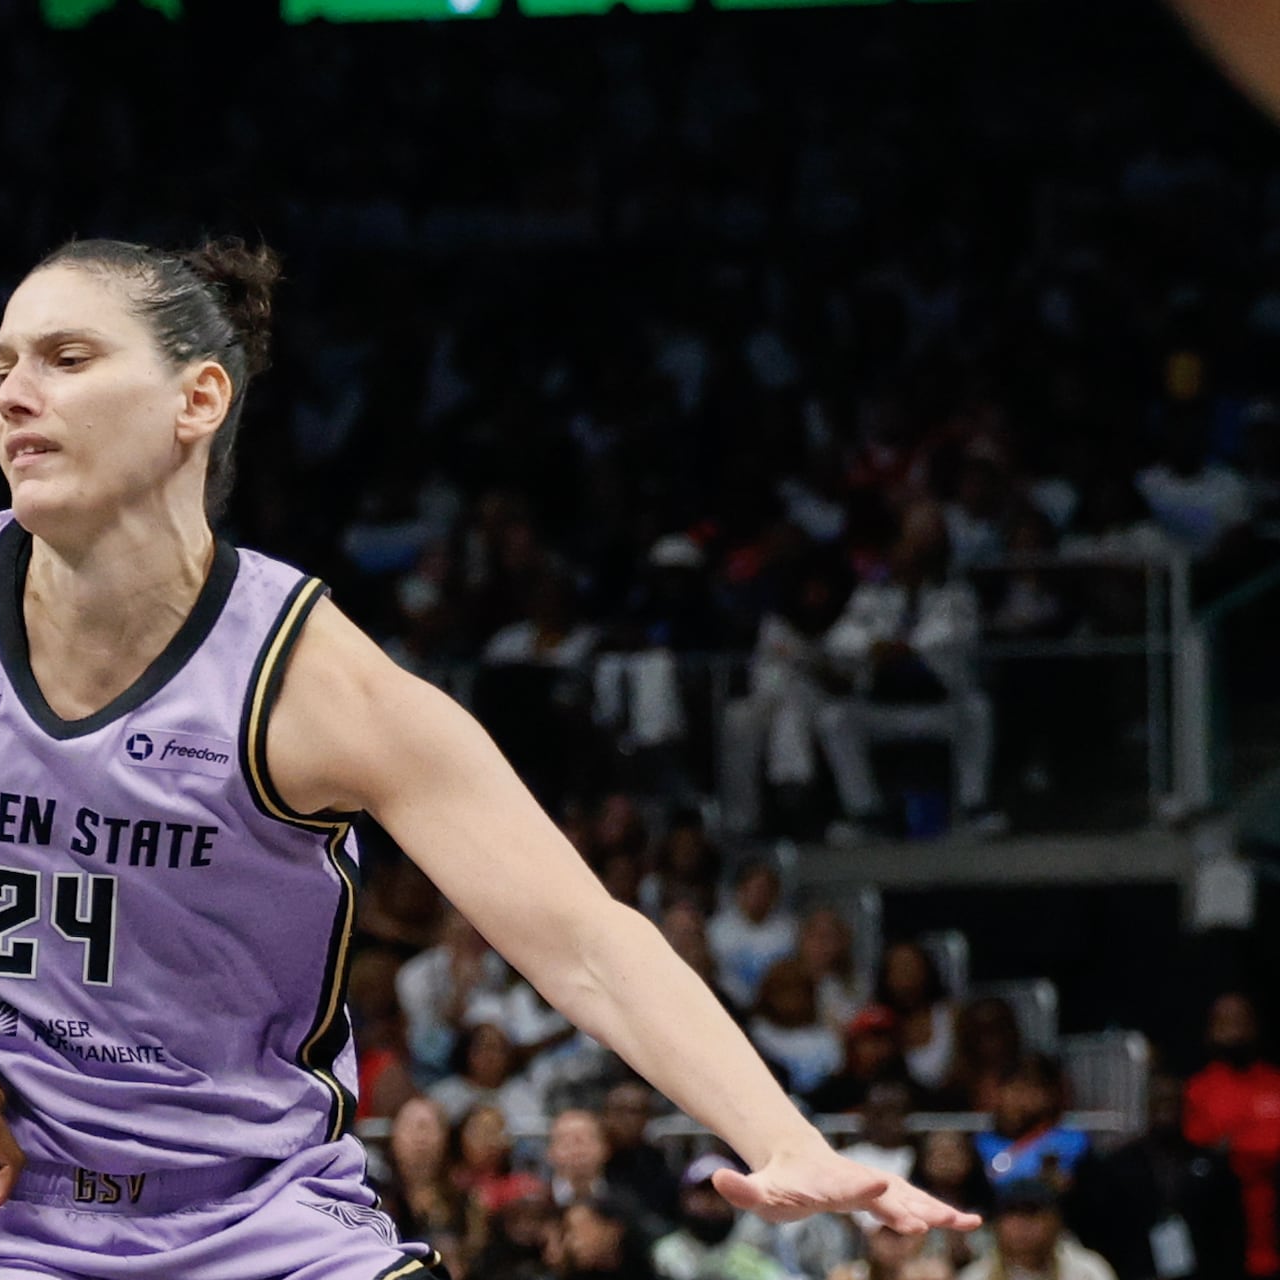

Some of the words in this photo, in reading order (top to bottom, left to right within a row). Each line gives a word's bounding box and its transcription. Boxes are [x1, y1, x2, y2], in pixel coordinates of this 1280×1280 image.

[159, 739, 230, 766] freedom
[70, 806, 219, 868] STATE
[73, 1166, 147, 1204] GSV
